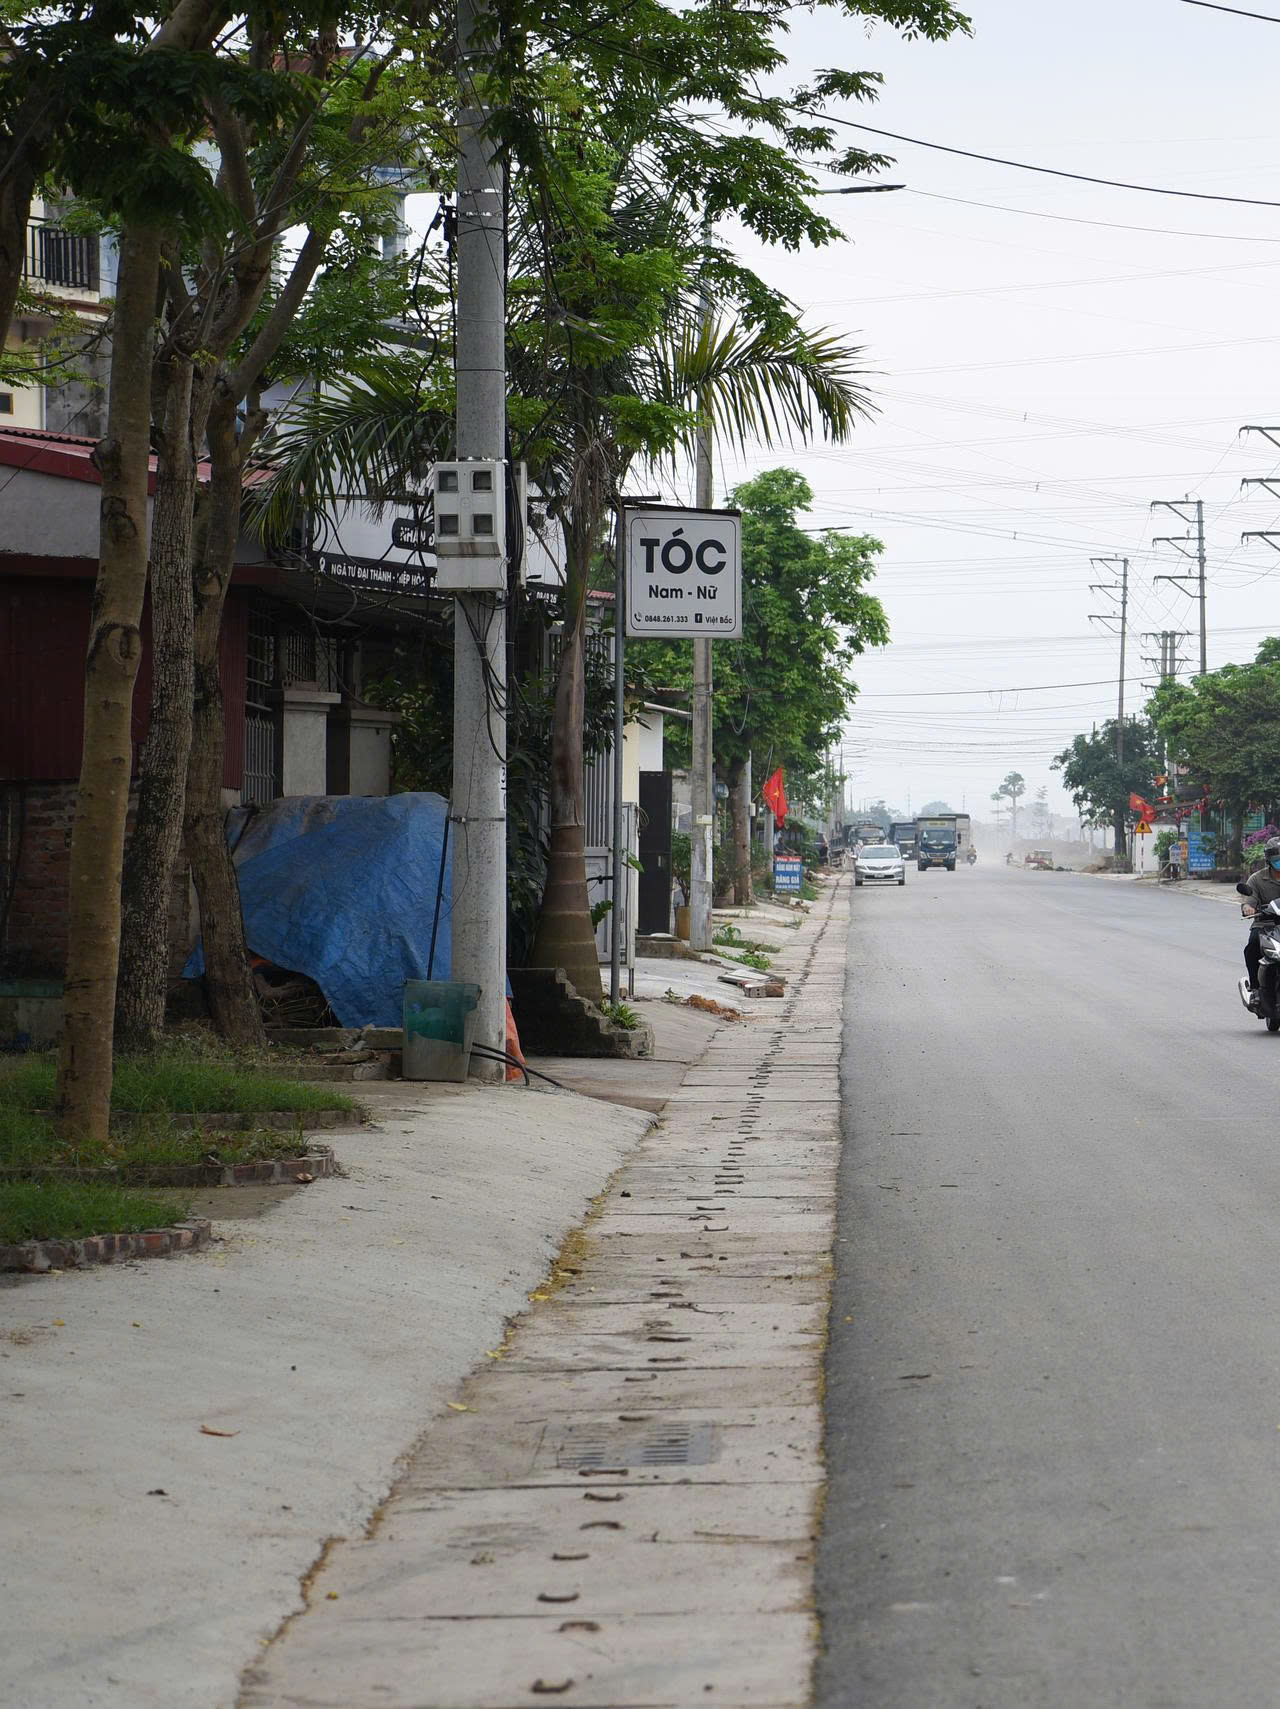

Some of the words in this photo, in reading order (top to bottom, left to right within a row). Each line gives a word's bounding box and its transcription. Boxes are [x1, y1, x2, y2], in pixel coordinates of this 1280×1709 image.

[640, 527, 727, 575] TÓC
[331, 562, 347, 576] NGÃ
[357, 567, 368, 581] ĐẠI
[649, 585, 683, 599] Nam
[697, 585, 718, 600] Nữ
[644, 615, 688, 623] 0848.261.333
